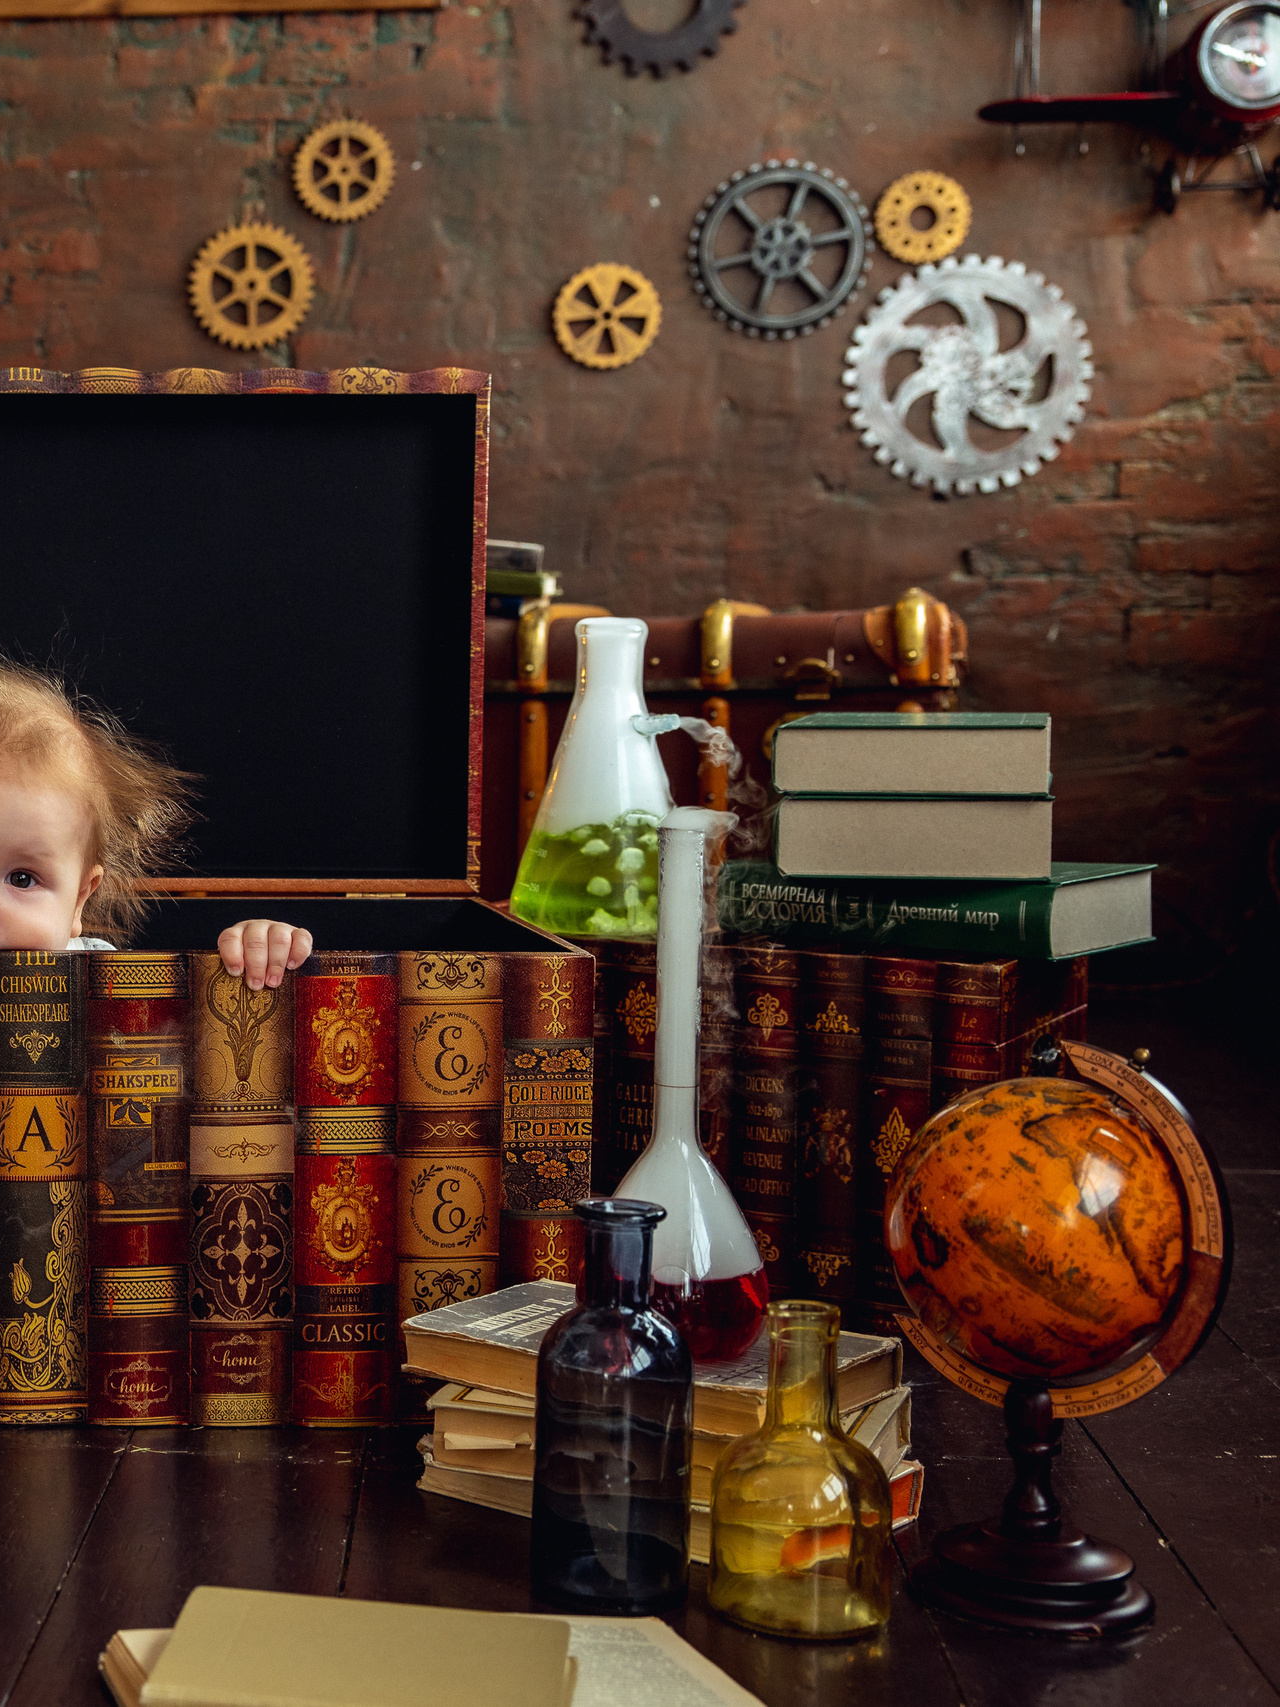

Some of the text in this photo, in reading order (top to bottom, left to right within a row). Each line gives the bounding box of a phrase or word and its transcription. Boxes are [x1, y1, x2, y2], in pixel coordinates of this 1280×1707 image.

[741, 883, 826, 905] ВСЕМИРНАЯ
[742, 900, 828, 924] ИСТОРИЯ
[887, 899, 1000, 932] Древний мир
[331, 965, 363, 975] LABEL
[0, 975, 68, 994] CHISWICK
[0, 1003, 70, 1023] SHAKESPEARE
[960, 1011, 978, 1029] Le
[95, 1074, 177, 1089] SHAKSPERE
[745, 1075, 785, 1094] DICKENS
[12, 1105, 59, 1152] A
[510, 1120, 593, 1140] POEMS
[742, 1151, 784, 1171] REVENUE
[758, 1178, 792, 1197] OFFICE
[329, 1287, 361, 1295] RETRO
[329, 1304, 361, 1313] LABEL
[301, 1322, 386, 1343] CLASSIC
[907, 1325, 928, 1350] ZONA
[213, 1350, 270, 1370] home
[110, 1376, 168, 1393] home
